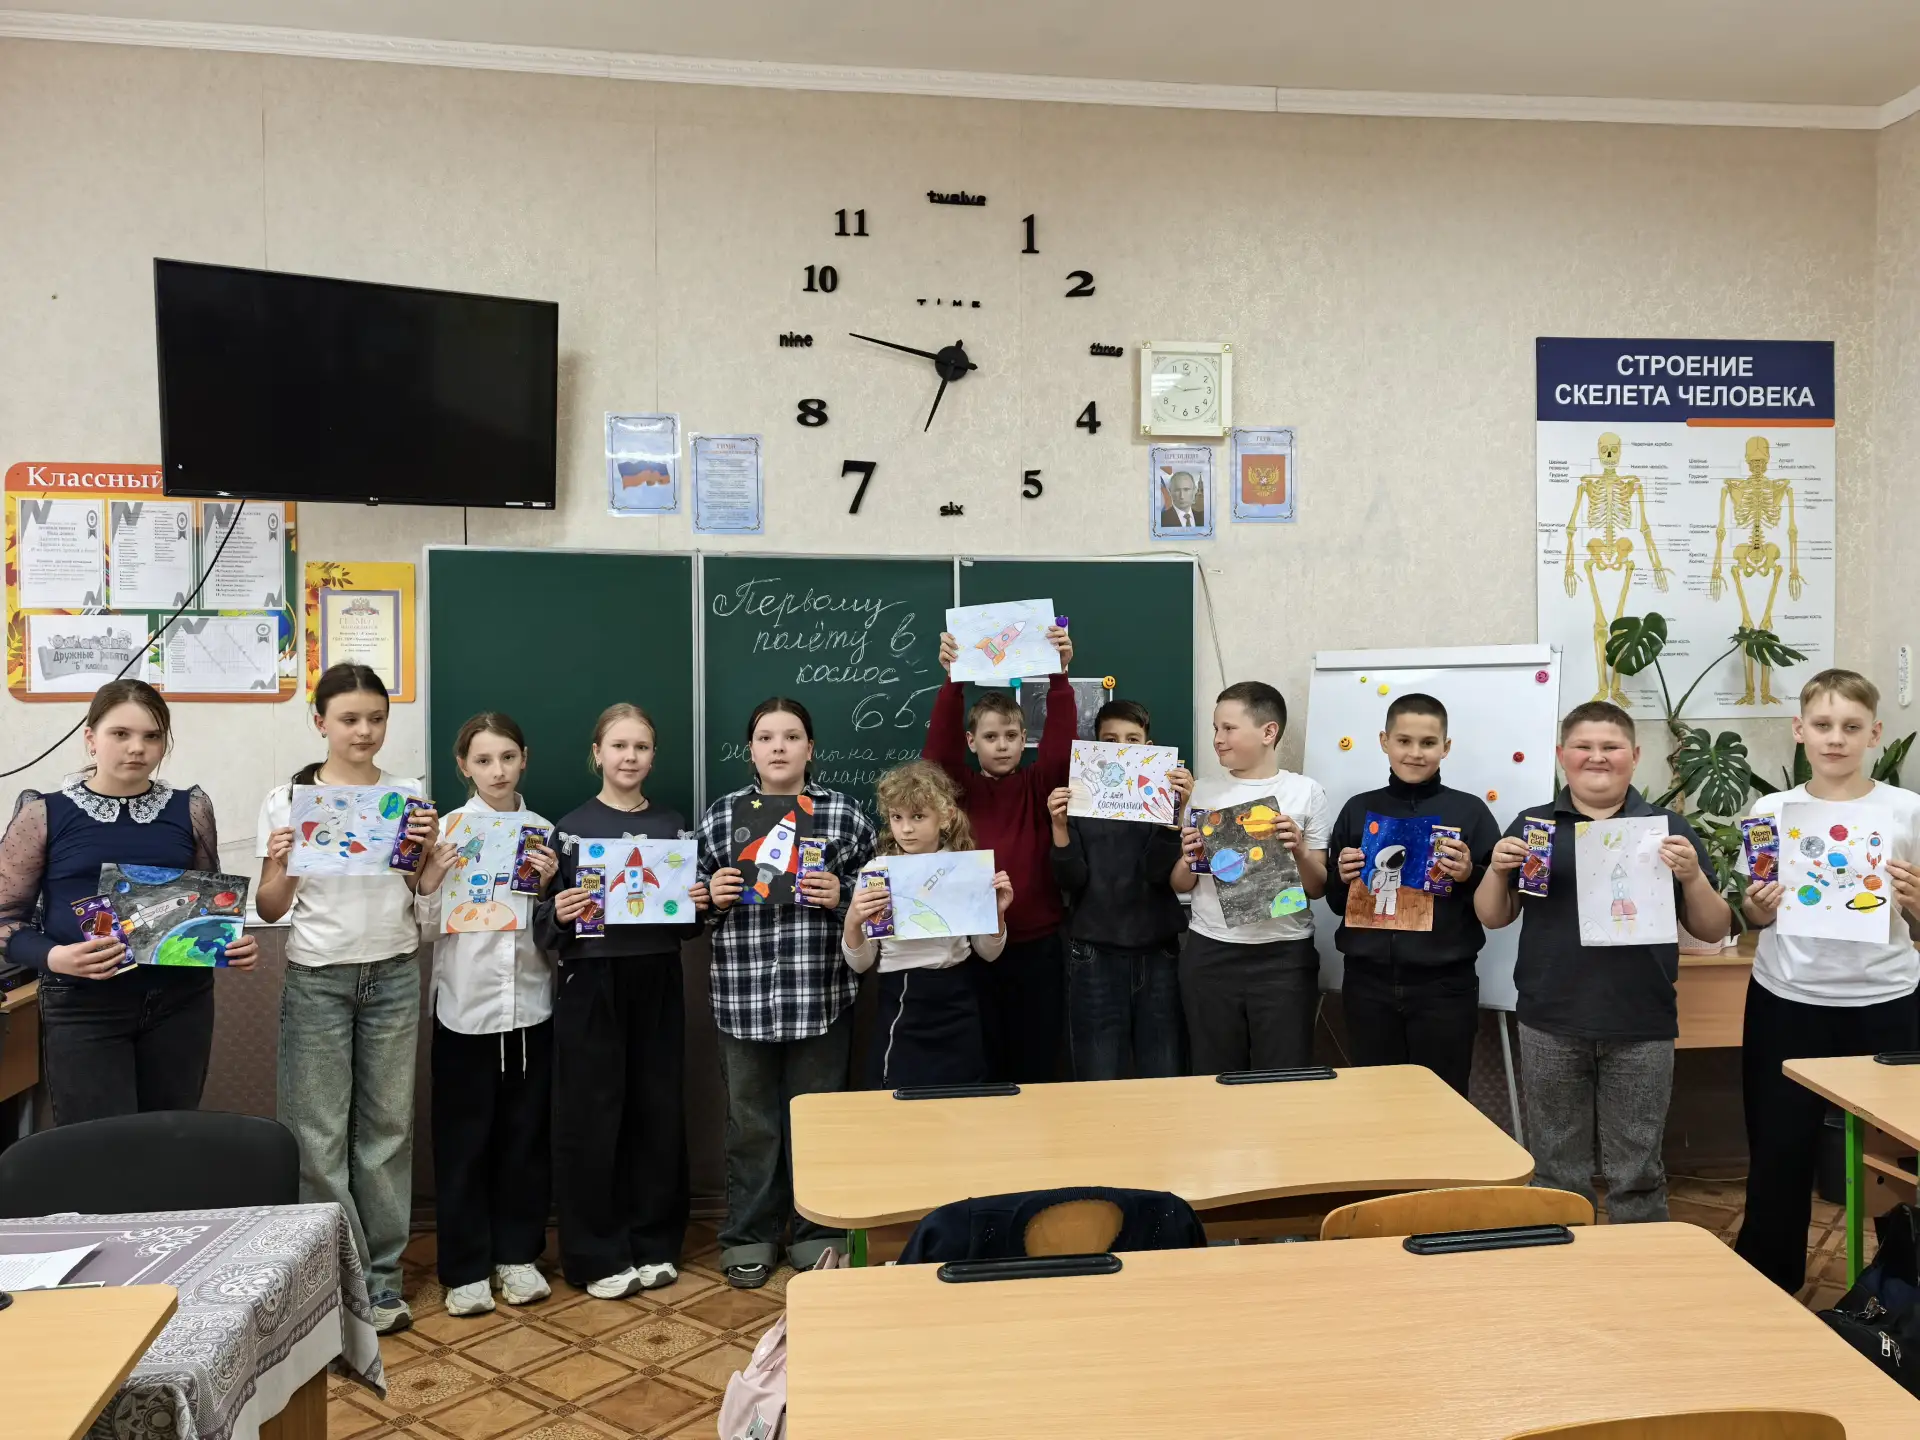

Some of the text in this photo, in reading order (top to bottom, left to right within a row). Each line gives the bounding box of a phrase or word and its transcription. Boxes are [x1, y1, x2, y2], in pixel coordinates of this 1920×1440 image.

[927, 190, 987, 206] twelve
[835, 209, 869, 236] 11
[1022, 214, 1039, 254] 1
[803, 265, 838, 293] 10
[1066, 270, 1095, 297] 2
[779, 332, 813, 347] nine
[1090, 342, 1123, 357] three
[1617, 355, 1754, 377] СТРОЕНИЕ
[1555, 384, 1815, 407] СКЕЛЕТА ЧЕЛОВЕКА
[797, 398, 828, 427] 8
[1076, 401, 1101, 434] 4
[27, 466, 163, 489] Классный
[841, 460, 876, 514] 7
[1022, 470, 1043, 499] 5
[940, 502, 963, 516] six
[712, 577, 907, 629] Первому
[753, 621, 872, 664] полёту
[53, 650, 94, 664] Дружные
[796, 664, 899, 684] космос
[1529, 832, 1547, 841] Alpen
[1530, 838, 1545, 846] Gold
[1751, 829, 1771, 839] Alpen
[1753, 835, 1769, 843] Gold
